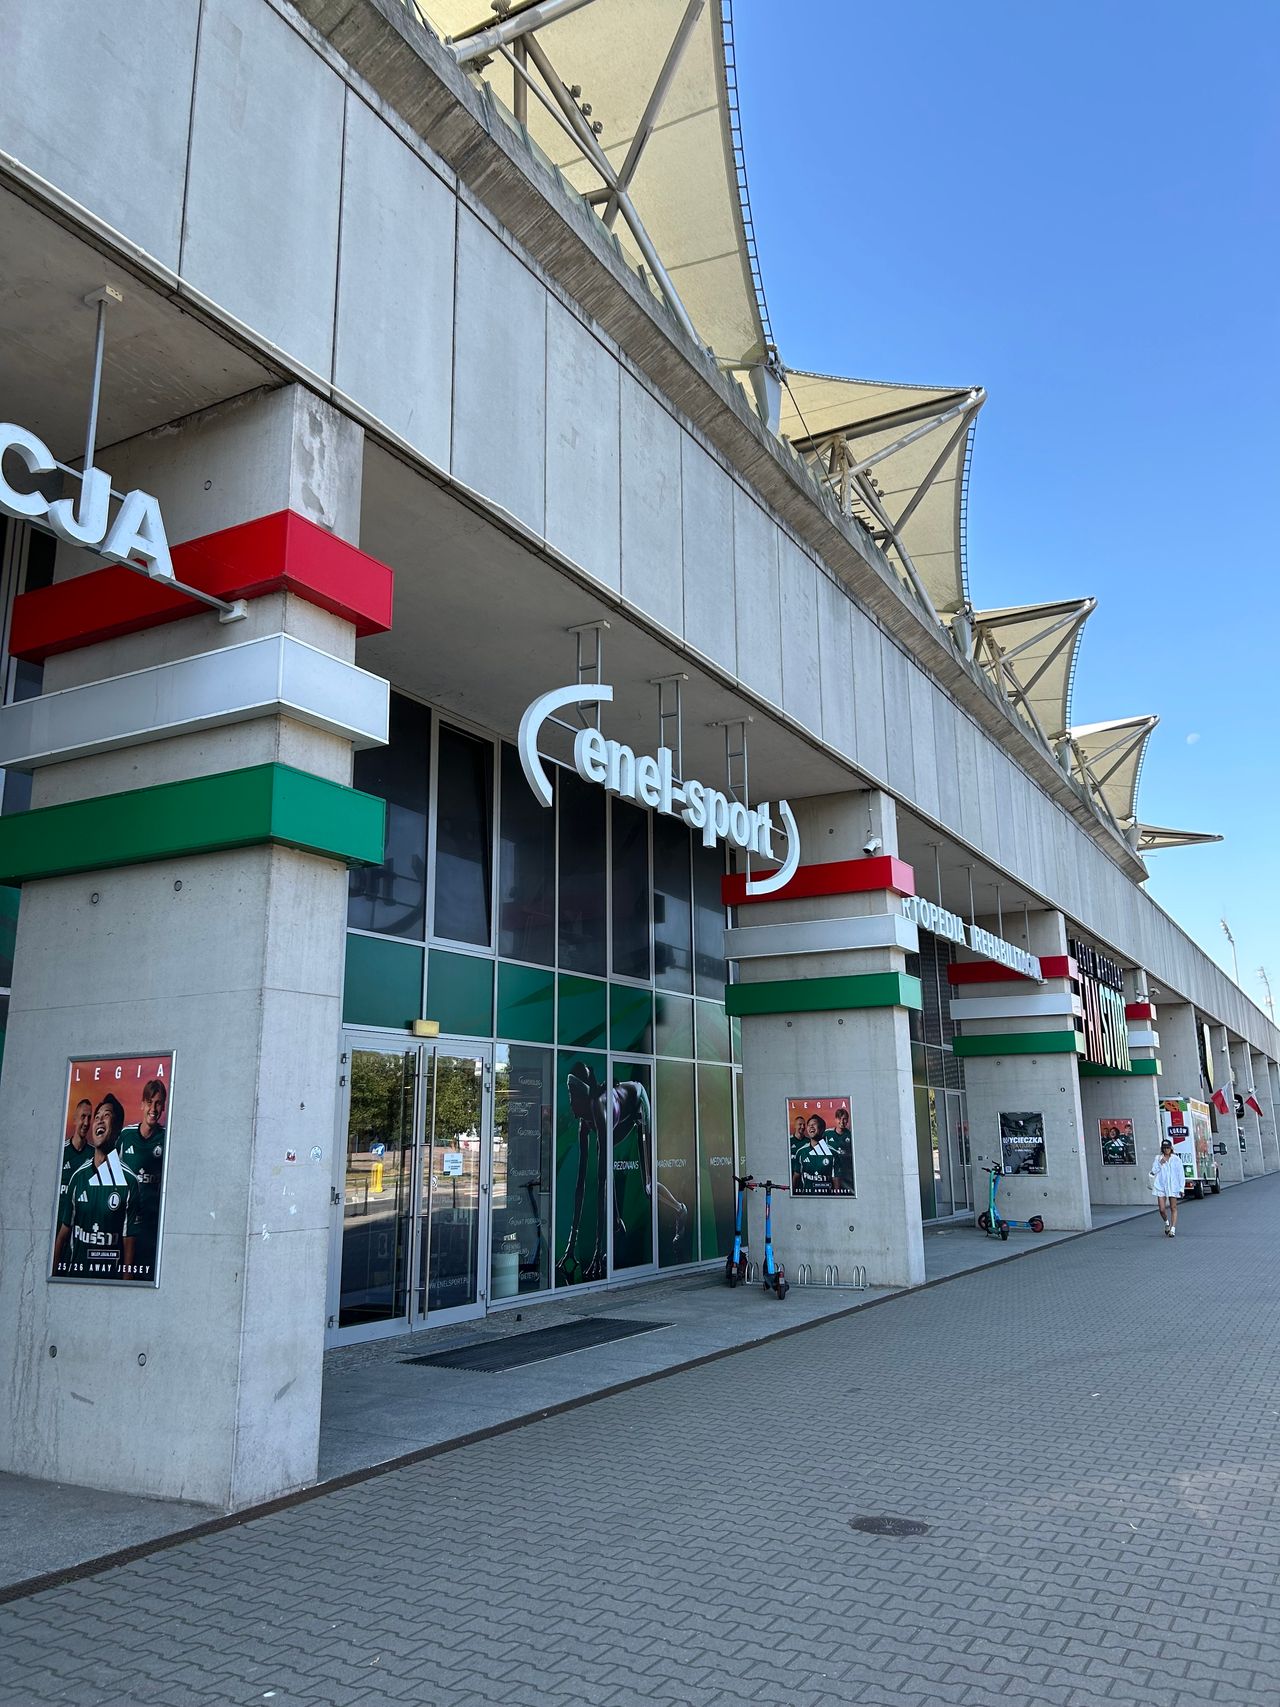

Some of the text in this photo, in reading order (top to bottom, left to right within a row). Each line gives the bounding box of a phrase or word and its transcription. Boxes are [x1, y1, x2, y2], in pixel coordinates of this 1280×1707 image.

[76, 1063, 164, 1082] LEGIA
[791, 1100, 848, 1110] LEGIA
[1003, 1136, 1043, 1144] WYCIECZKA
[613, 1160, 639, 1171] REZONANS
[57, 1262, 151, 1274] 25/26 AWAY JERSEY
